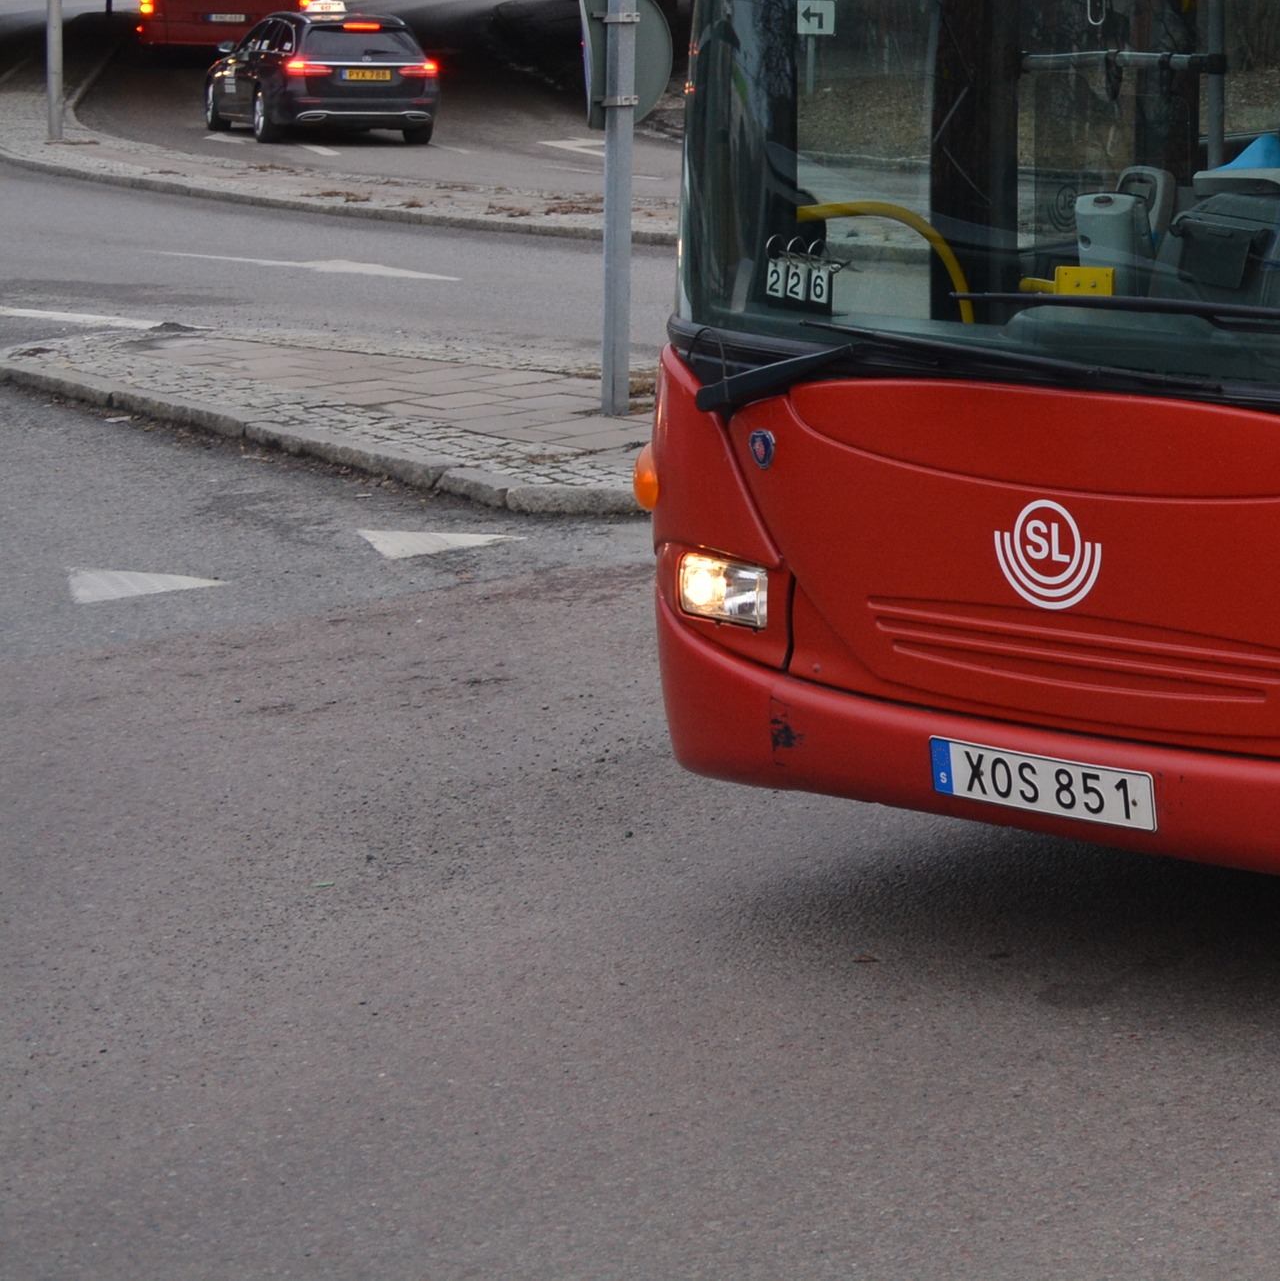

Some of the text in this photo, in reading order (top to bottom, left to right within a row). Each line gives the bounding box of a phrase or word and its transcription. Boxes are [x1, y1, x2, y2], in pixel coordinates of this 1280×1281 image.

[768, 269, 824, 299] 226
[1025, 519, 1071, 563] SL
[940, 772, 948, 784] S
[964, 750, 1131, 820] XOS 851
